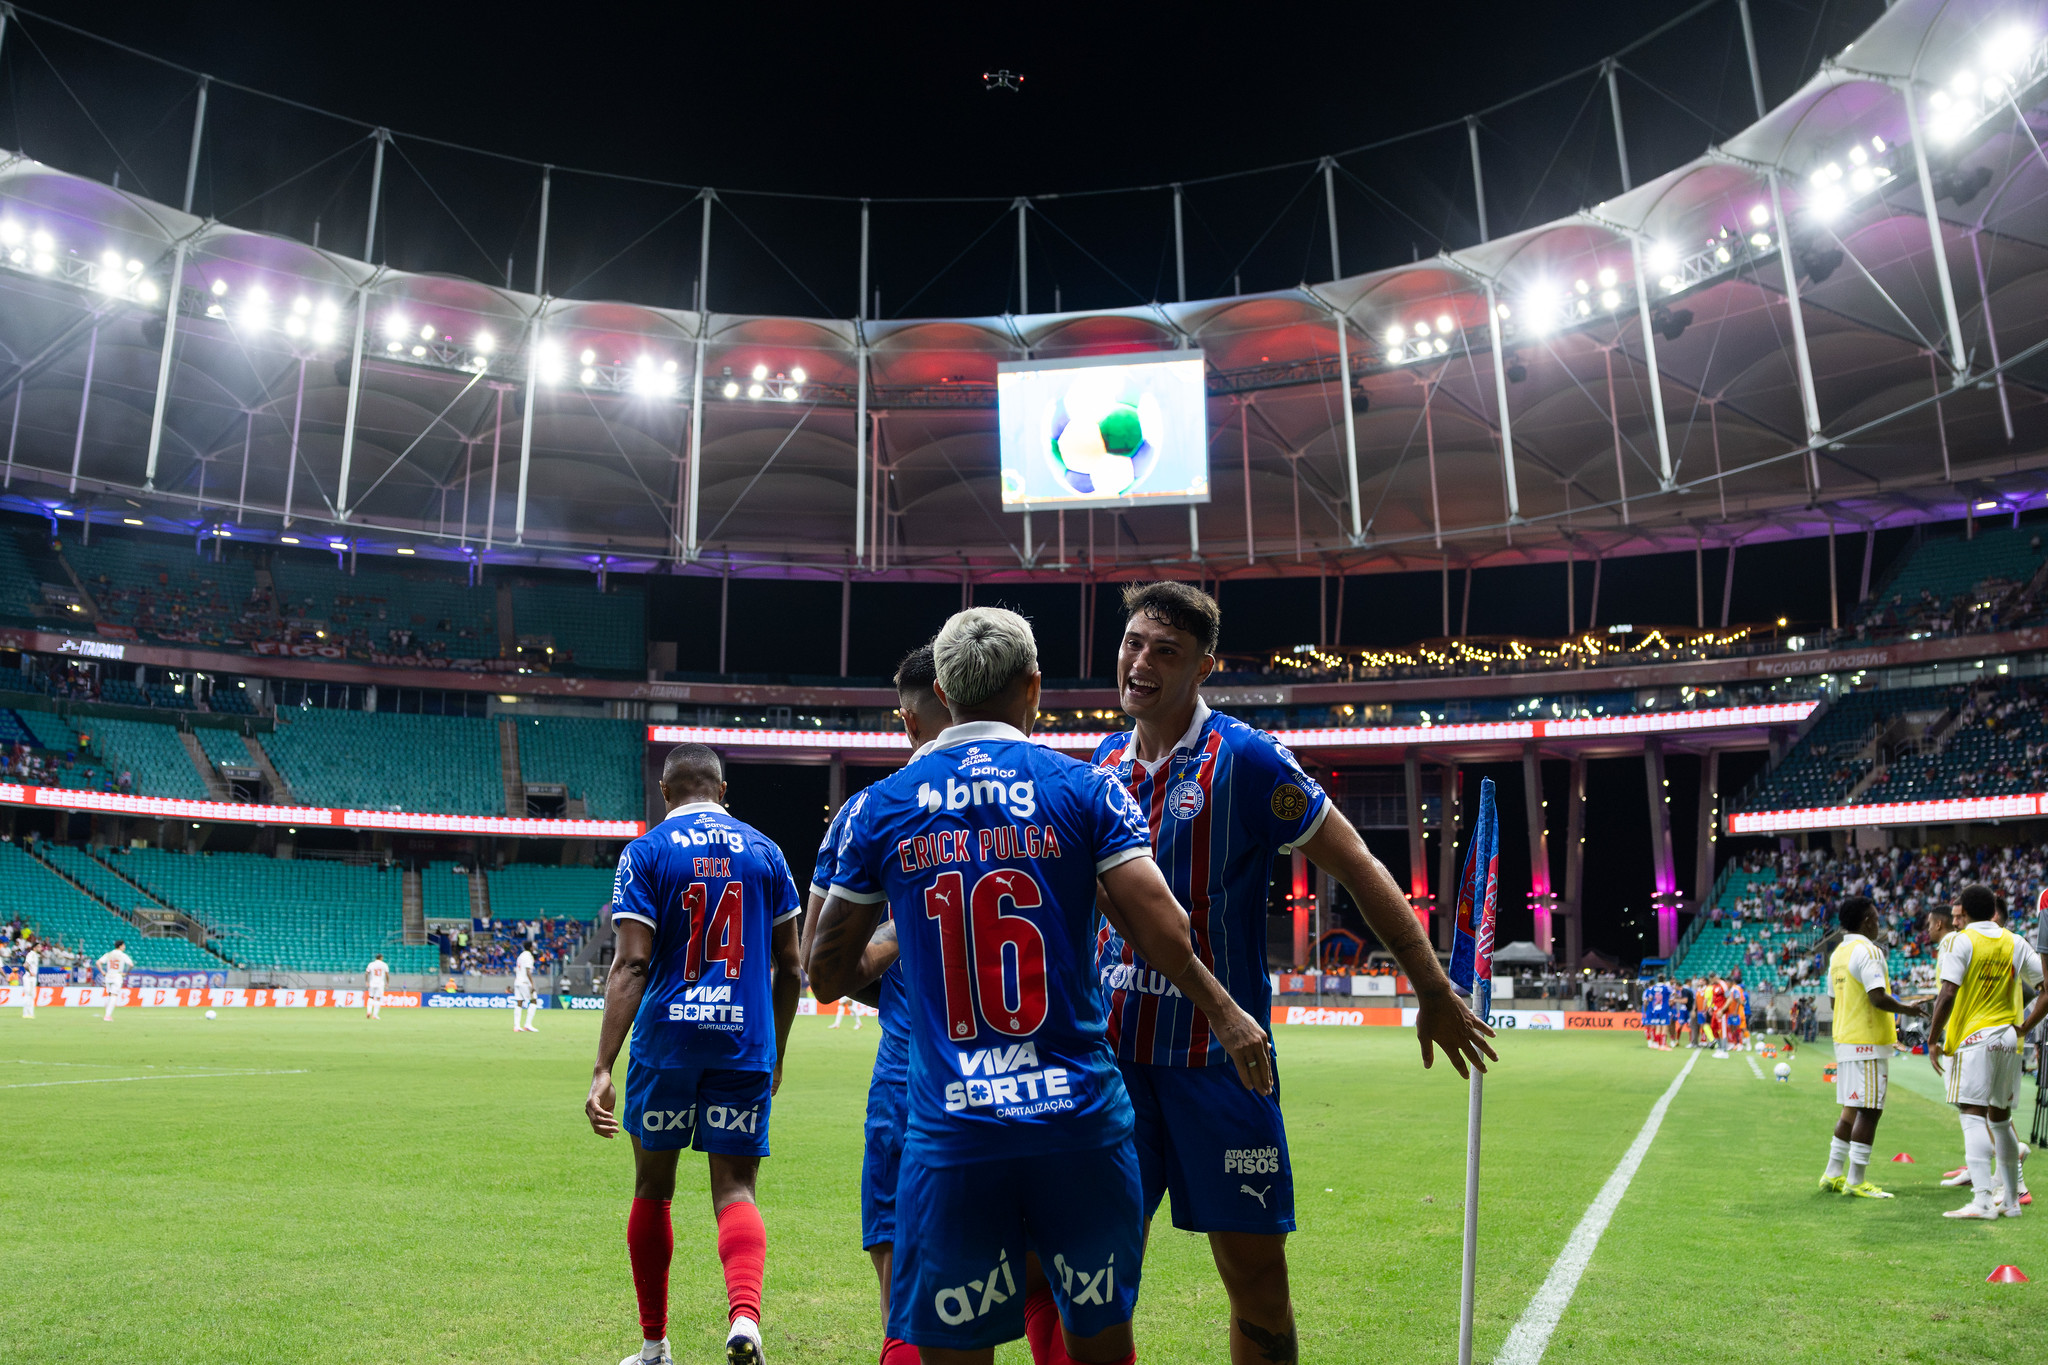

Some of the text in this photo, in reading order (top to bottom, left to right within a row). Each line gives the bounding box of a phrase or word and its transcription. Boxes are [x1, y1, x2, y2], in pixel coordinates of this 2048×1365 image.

[1773, 652, 1888, 674] CASA DE APOSTAS
[971, 766, 1016, 778] banco
[947, 778, 1036, 818] bmg
[688, 828, 744, 853] bmg
[898, 824, 1061, 874] ERICK PULGA
[693, 857, 731, 878] ERICK
[681, 881, 745, 982] 14
[924, 868, 1049, 1042] 16
[127, 972, 208, 987] ERROR
[380, 993, 418, 1007] etano
[571, 996, 605, 1009] SICOO
[685, 985, 731, 1003] VIVA
[668, 1003, 744, 1023] SORTE
[1286, 1006, 1364, 1026] Betano
[1486, 1015, 1515, 1028] ora
[1568, 1017, 1613, 1027] FOXLUX
[698, 1023, 744, 1032] CAPITALIZAÇÃO
[958, 1041, 1039, 1077] VIVA
[945, 1068, 1071, 1112] SORTE
[996, 1099, 1073, 1119] CAPITALIZAÇÃO
[1224, 1145, 1278, 1159] ATACADÃO
[1224, 1157, 1279, 1174] PISOS
